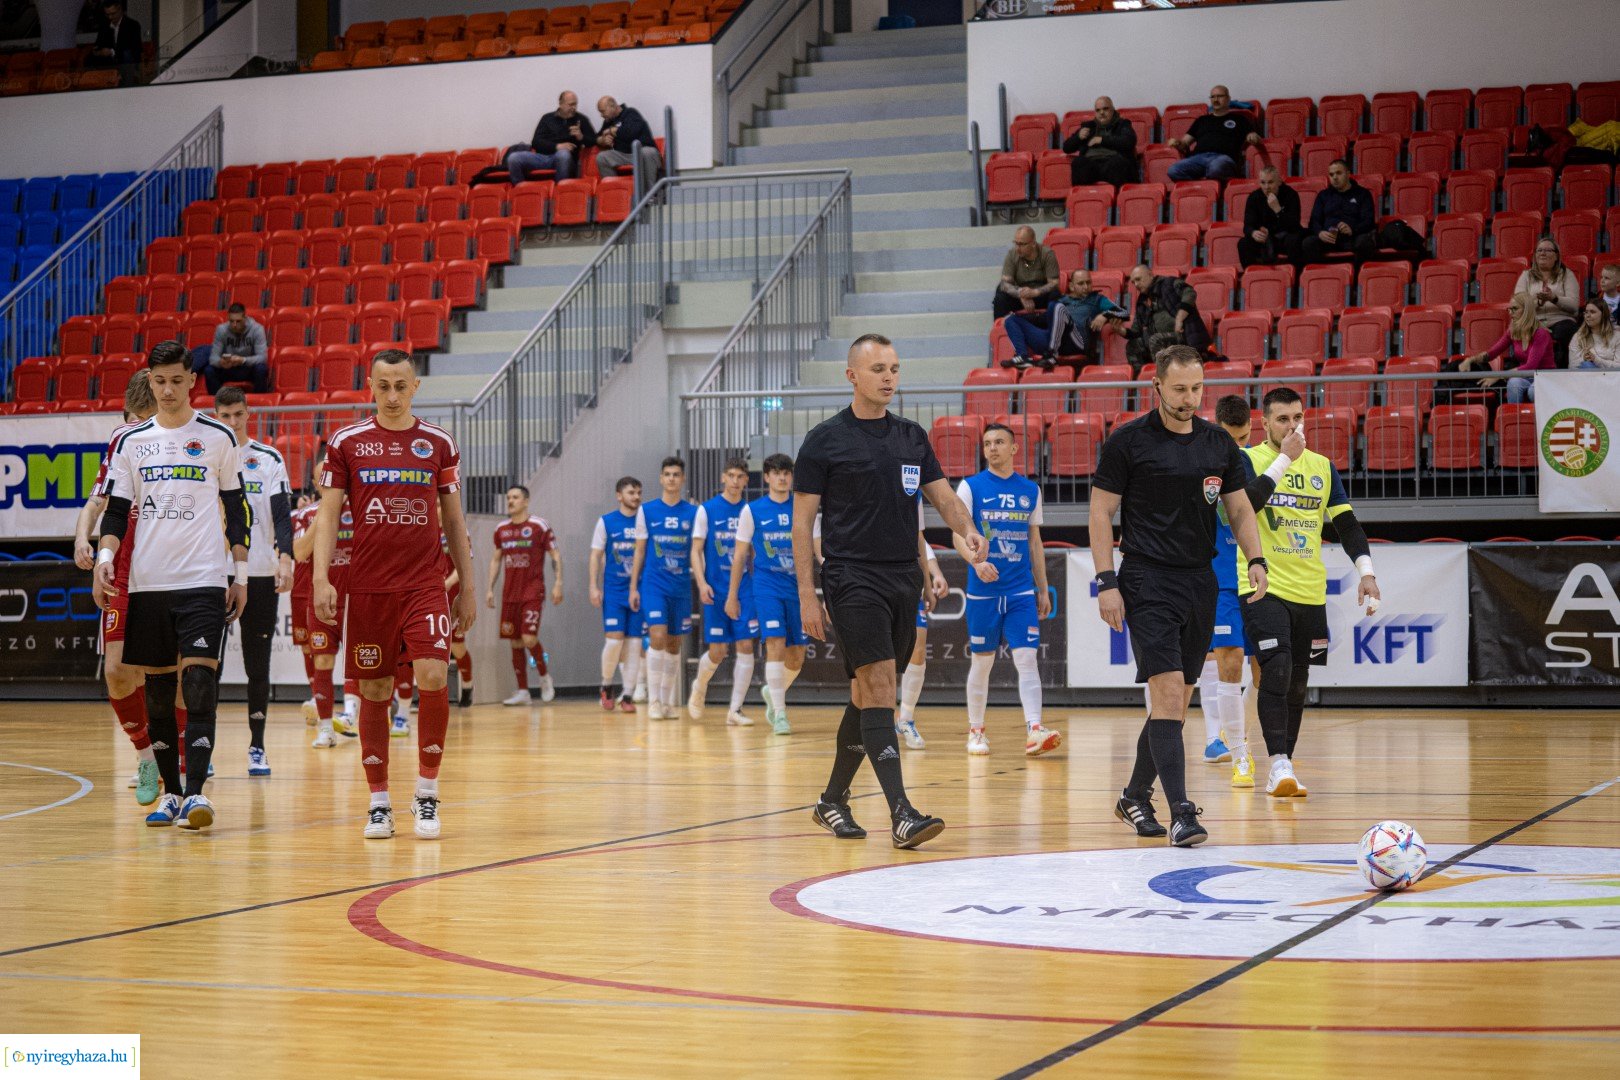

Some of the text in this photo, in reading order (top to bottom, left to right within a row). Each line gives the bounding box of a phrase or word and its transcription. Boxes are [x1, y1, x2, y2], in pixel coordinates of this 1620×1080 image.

[136, 442, 160, 459] 383
[355, 442, 384, 457] 383
[904, 467, 919, 475] FIFA
[1565, 468, 1586, 477] 1901
[1285, 474, 1304, 489] 30
[998, 494, 1015, 508] 75
[142, 510, 195, 520] STUDIO
[365, 514, 428, 525] STUDIO
[778, 513, 789, 526] 19
[665, 517, 679, 529] 25
[525, 610, 540, 624] 22
[425, 613, 450, 637] 10
[55, 636, 95, 649] KFT
[1353, 625, 1433, 664] KFT
[359, 648, 378, 657] 99.4
[1545, 631, 1620, 668] ST
